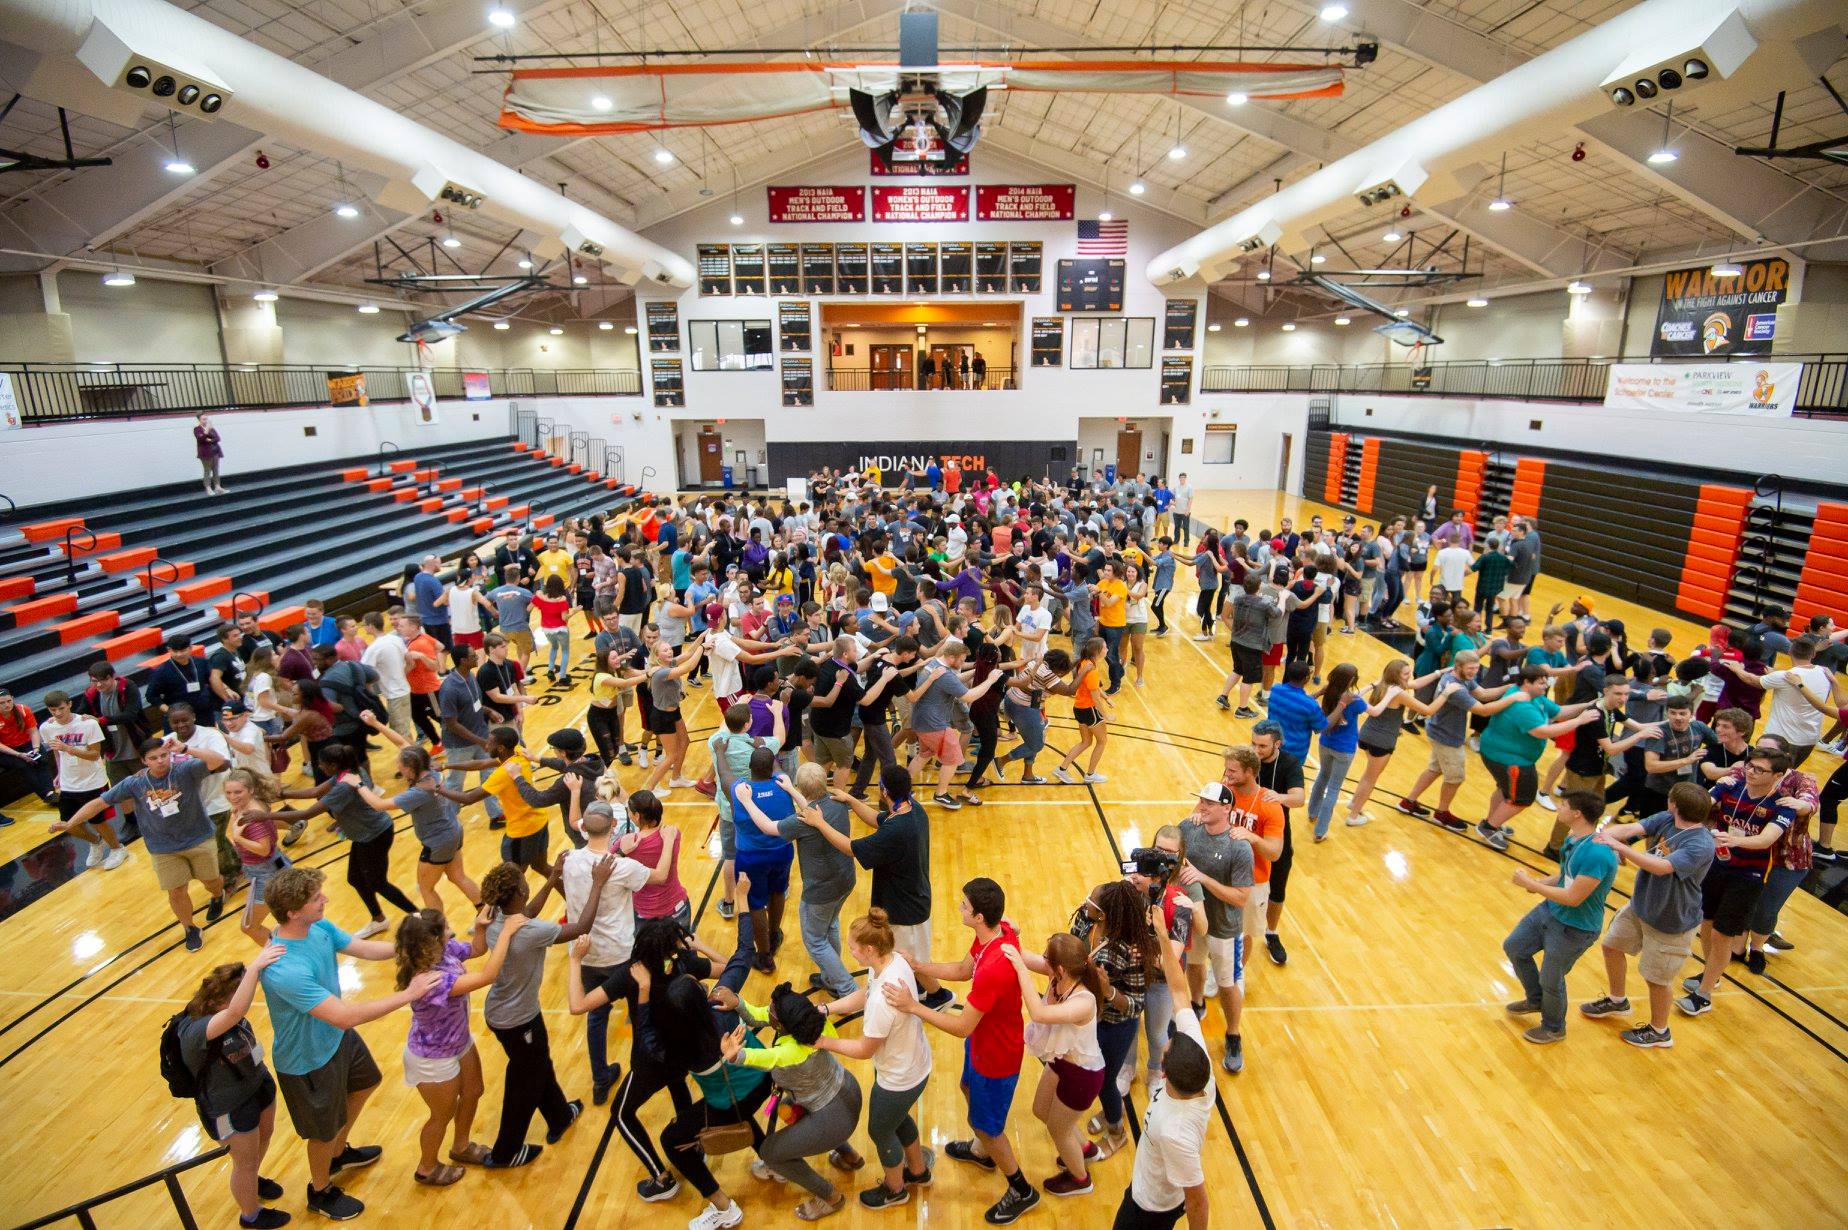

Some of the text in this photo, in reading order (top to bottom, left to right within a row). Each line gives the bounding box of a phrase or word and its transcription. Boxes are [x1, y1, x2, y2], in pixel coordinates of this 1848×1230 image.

[1666, 261, 1789, 300] WARRIOR
[1684, 297, 1695, 308] THE
[1697, 296, 1716, 307] FIGHT
[1717, 293, 1748, 306] AGAINST
[1748, 291, 1777, 304] CANCER
[1653, 377, 1661, 385] to
[1693, 371, 1732, 379] PARKVIEW
[859, 455, 939, 473] INDIANA
[1723, 814, 1760, 834] QATAR
